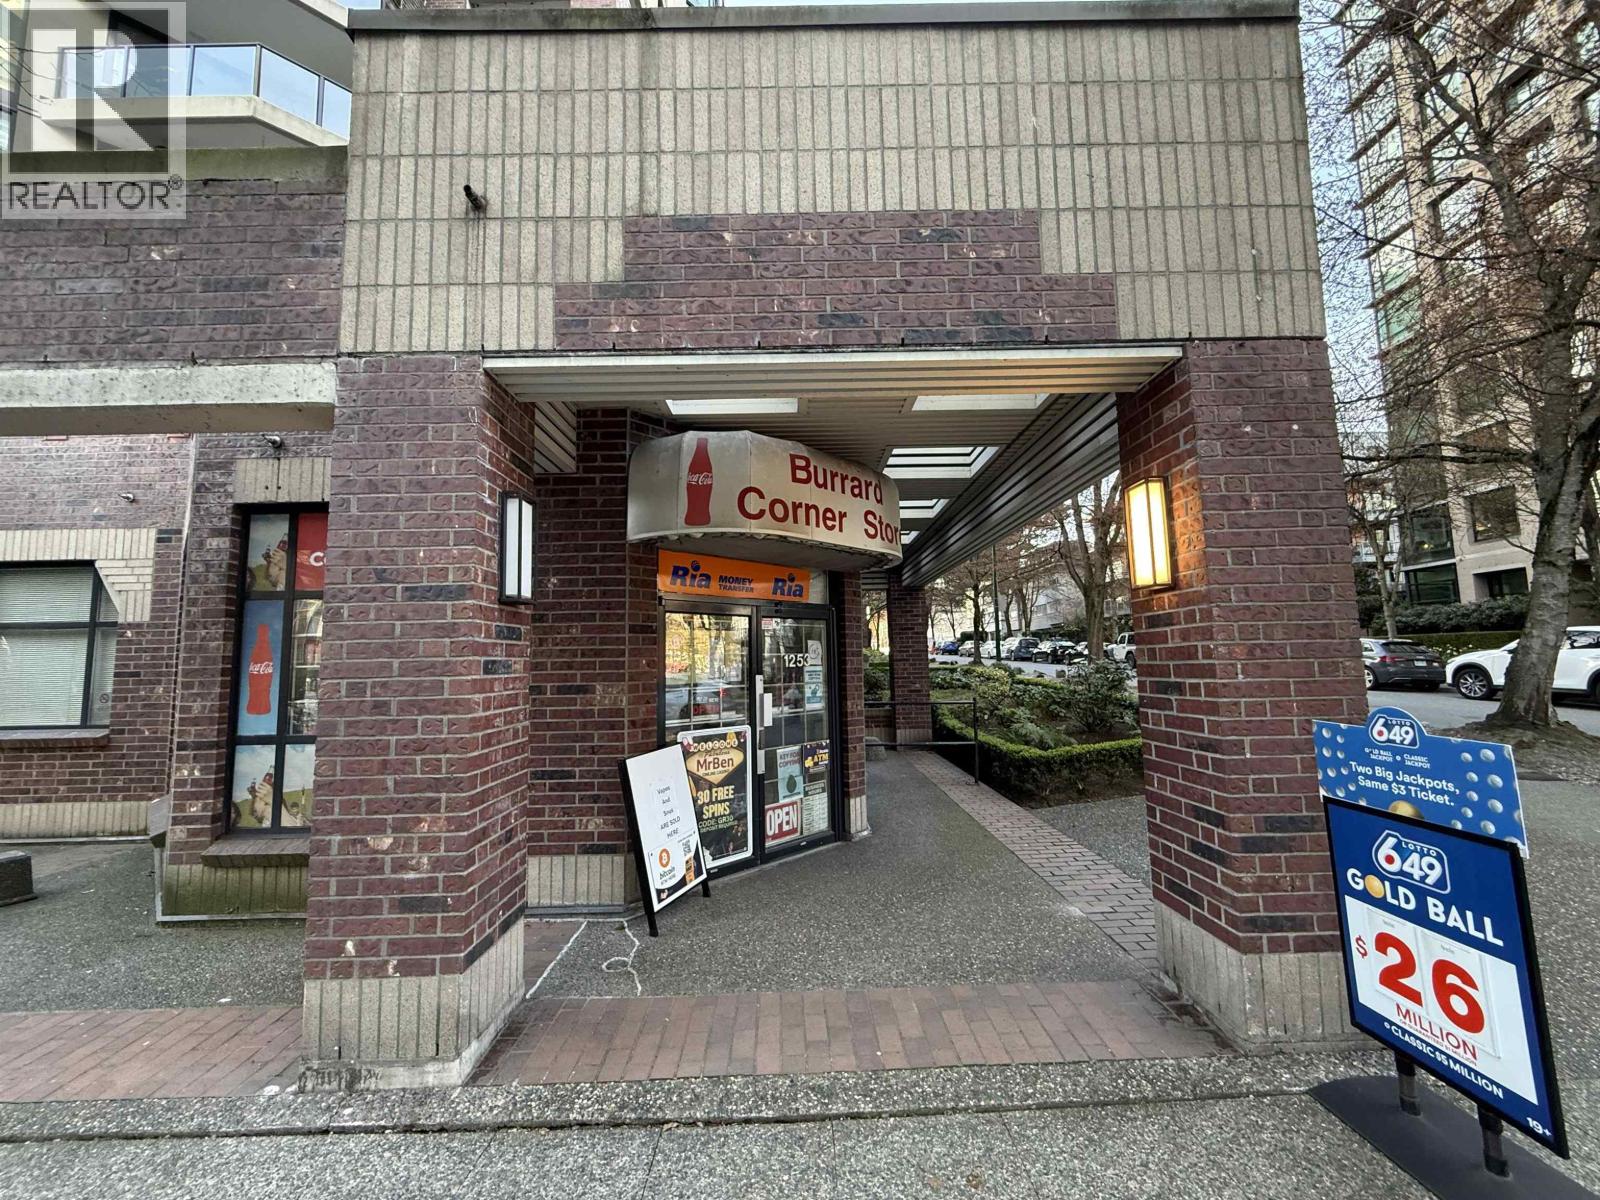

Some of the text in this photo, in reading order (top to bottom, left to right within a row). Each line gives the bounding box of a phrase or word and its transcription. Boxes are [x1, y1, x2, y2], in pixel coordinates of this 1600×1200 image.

[789, 453, 884, 506] Burrard
[737, 486, 848, 533] Corner
[310, 551, 327, 567] C
[669, 560, 804, 598] Ria MONEY Ria
[718, 584, 754, 593] TRANSFER
[1372, 717, 1415, 745] 649
[693, 739, 739, 752] WELCOME
[1364, 747, 1379, 755] GLD
[696, 757, 735, 772] MrBen
[813, 752, 829, 764] ATM
[1369, 754, 1394, 762] JACKPOT
[1403, 753, 1429, 763] CLASSIC
[1405, 760, 1431, 769] JACKPOT
[1349, 761, 1460, 795] Two Big Jackpots,
[696, 785, 735, 805] 30 FREE
[1358, 775, 1455, 807] Same $3 Ticket.
[702, 801, 730, 820] SPINS
[766, 804, 798, 836] OPEN
[1401, 841, 1437, 857] LOTTO
[1377, 836, 1443, 886] 649
[1426, 896, 1504, 947] BALL
[1395, 1002, 1478, 1062] MILLION
[1391, 1025, 1436, 1058] CLASSIC
[1448, 1059, 1504, 1100] MILLION
[1526, 1116, 1552, 1137] 19+
